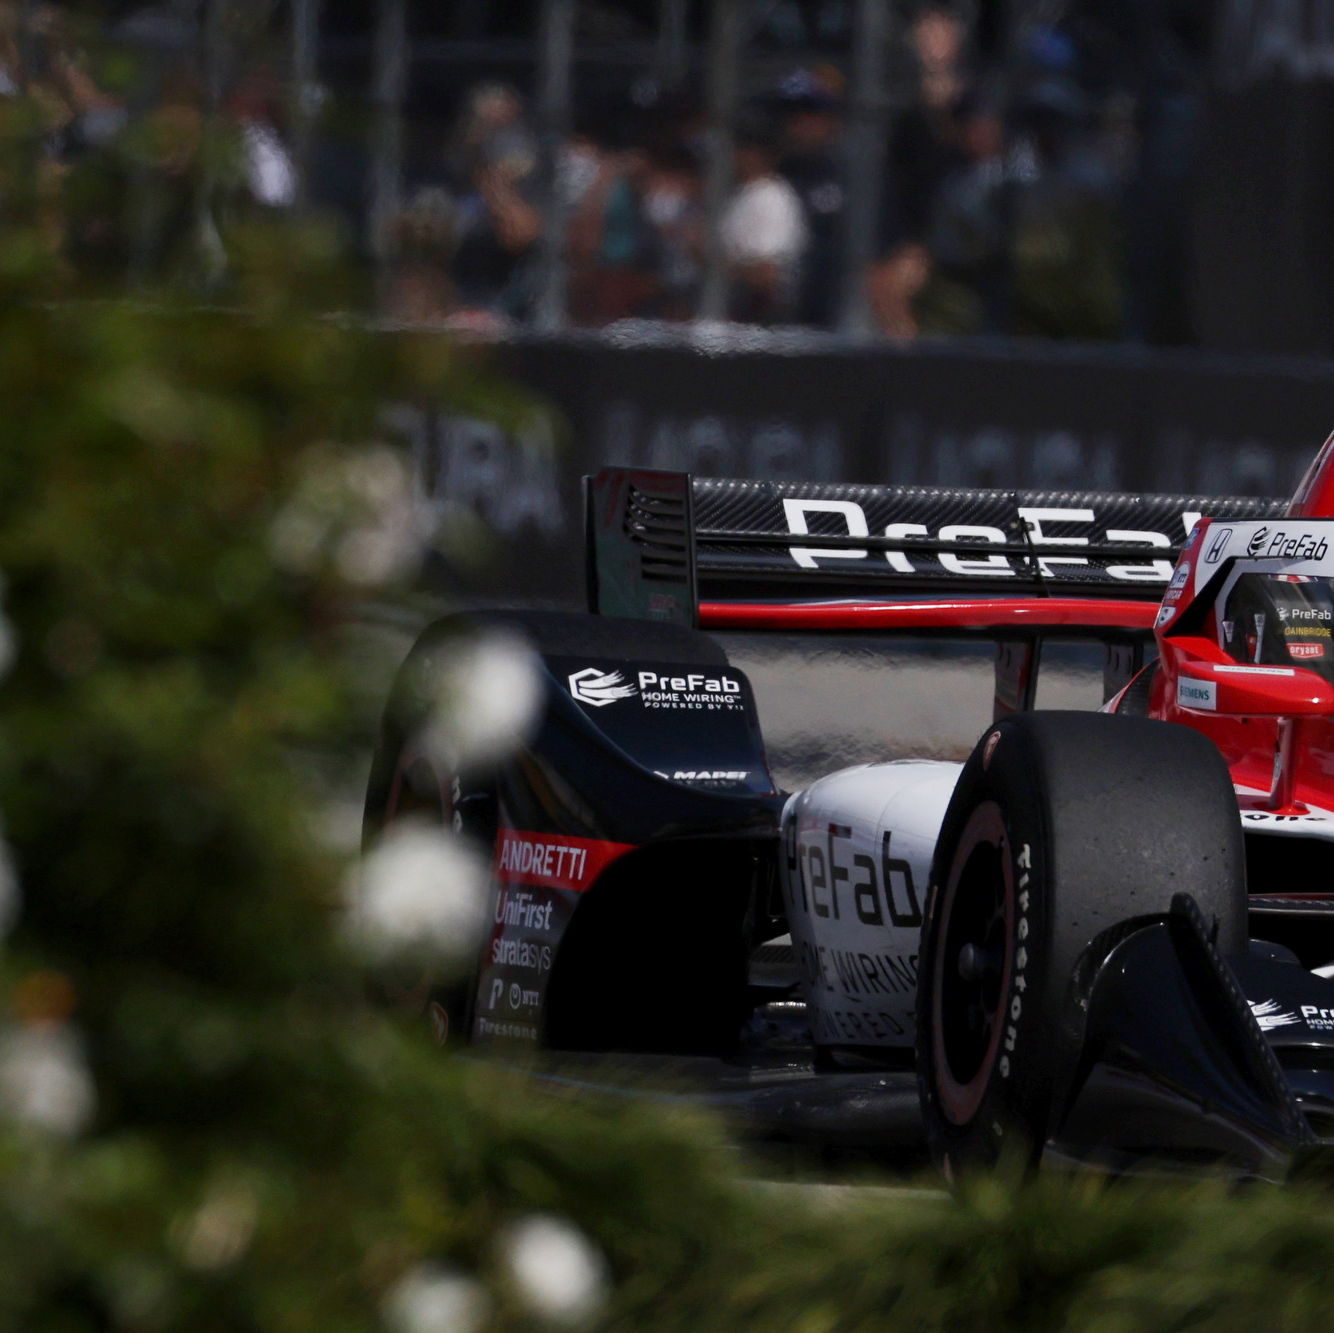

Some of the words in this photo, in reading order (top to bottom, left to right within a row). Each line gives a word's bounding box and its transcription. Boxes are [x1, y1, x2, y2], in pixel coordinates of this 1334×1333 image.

[781, 497, 1203, 584] PreFa
[1266, 532, 1329, 562] PreFab
[1291, 608, 1332, 620] PreFab
[637, 671, 740, 693] PreFab
[1179, 685, 1210, 701] SIEMENS
[641, 691, 681, 702] HOME
[643, 701, 703, 710] POWERED
[707, 703, 722, 711] BY
[672, 771, 751, 781] MAPEI
[498, 839, 588, 881] ANDRETTI
[494, 890, 553, 931] UniFirst
[492, 937, 552, 976] stratasys
[999, 843, 1031, 1078] Firestone
[478, 1016, 539, 1042] Firestone
